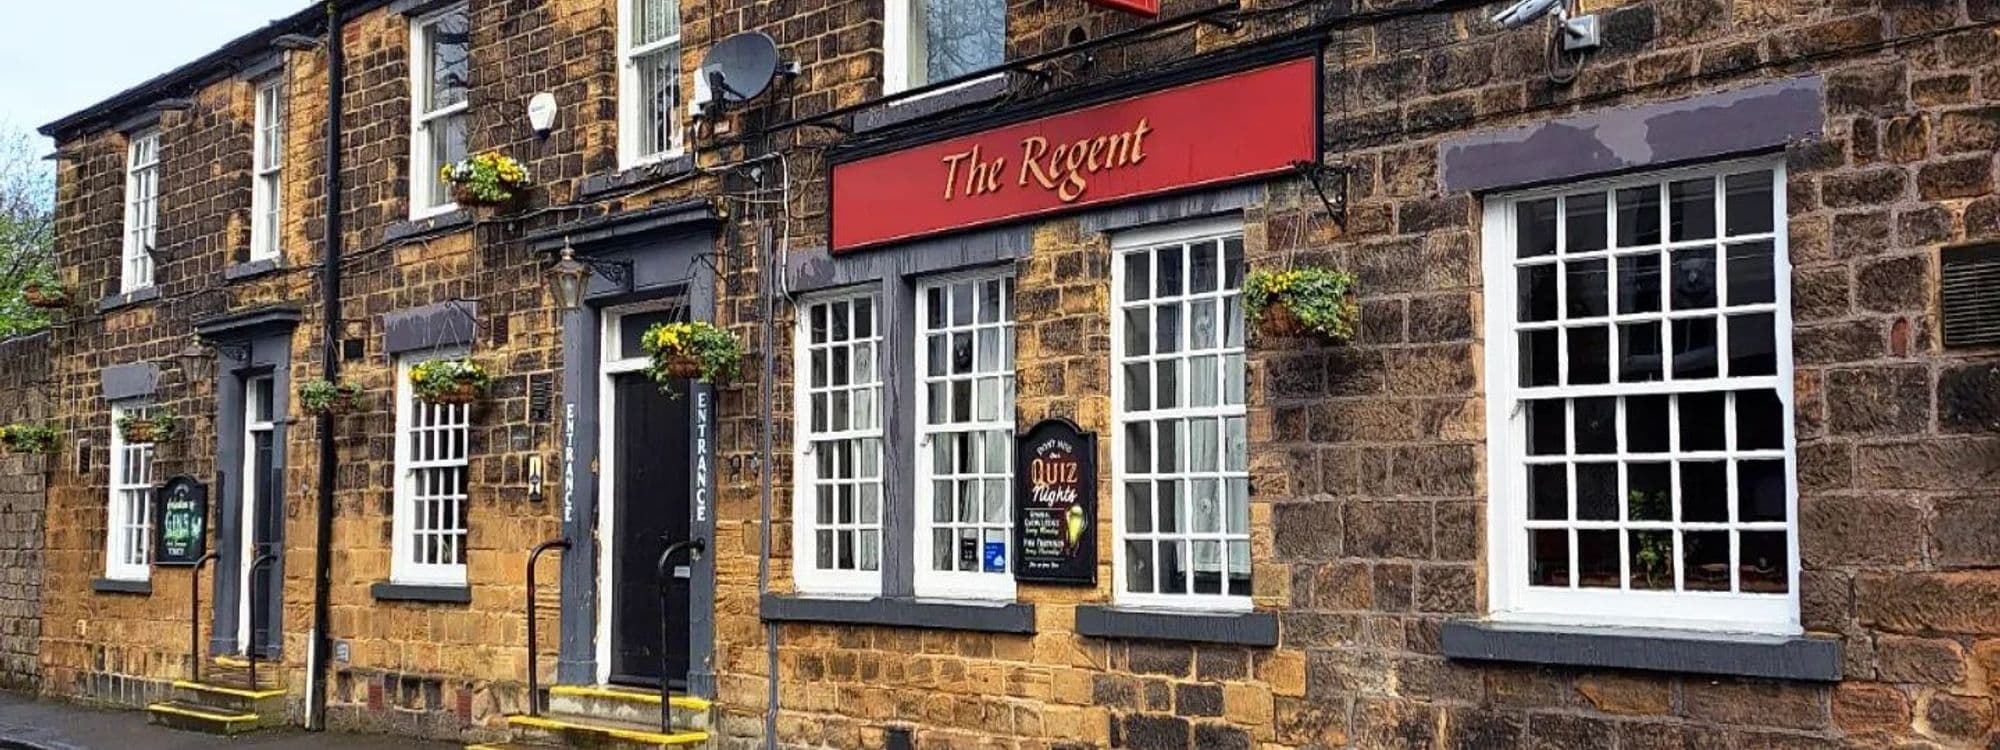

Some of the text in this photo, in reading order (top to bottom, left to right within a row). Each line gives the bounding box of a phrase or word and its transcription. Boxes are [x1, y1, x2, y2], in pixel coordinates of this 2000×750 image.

[942, 116, 1152, 202] The Regent
[565, 403, 575, 523] ENTRANCE
[696, 391, 708, 522] ENTRANCE
[1031, 458, 1078, 487] QUIZ
[1032, 485, 1078, 507] Nights
